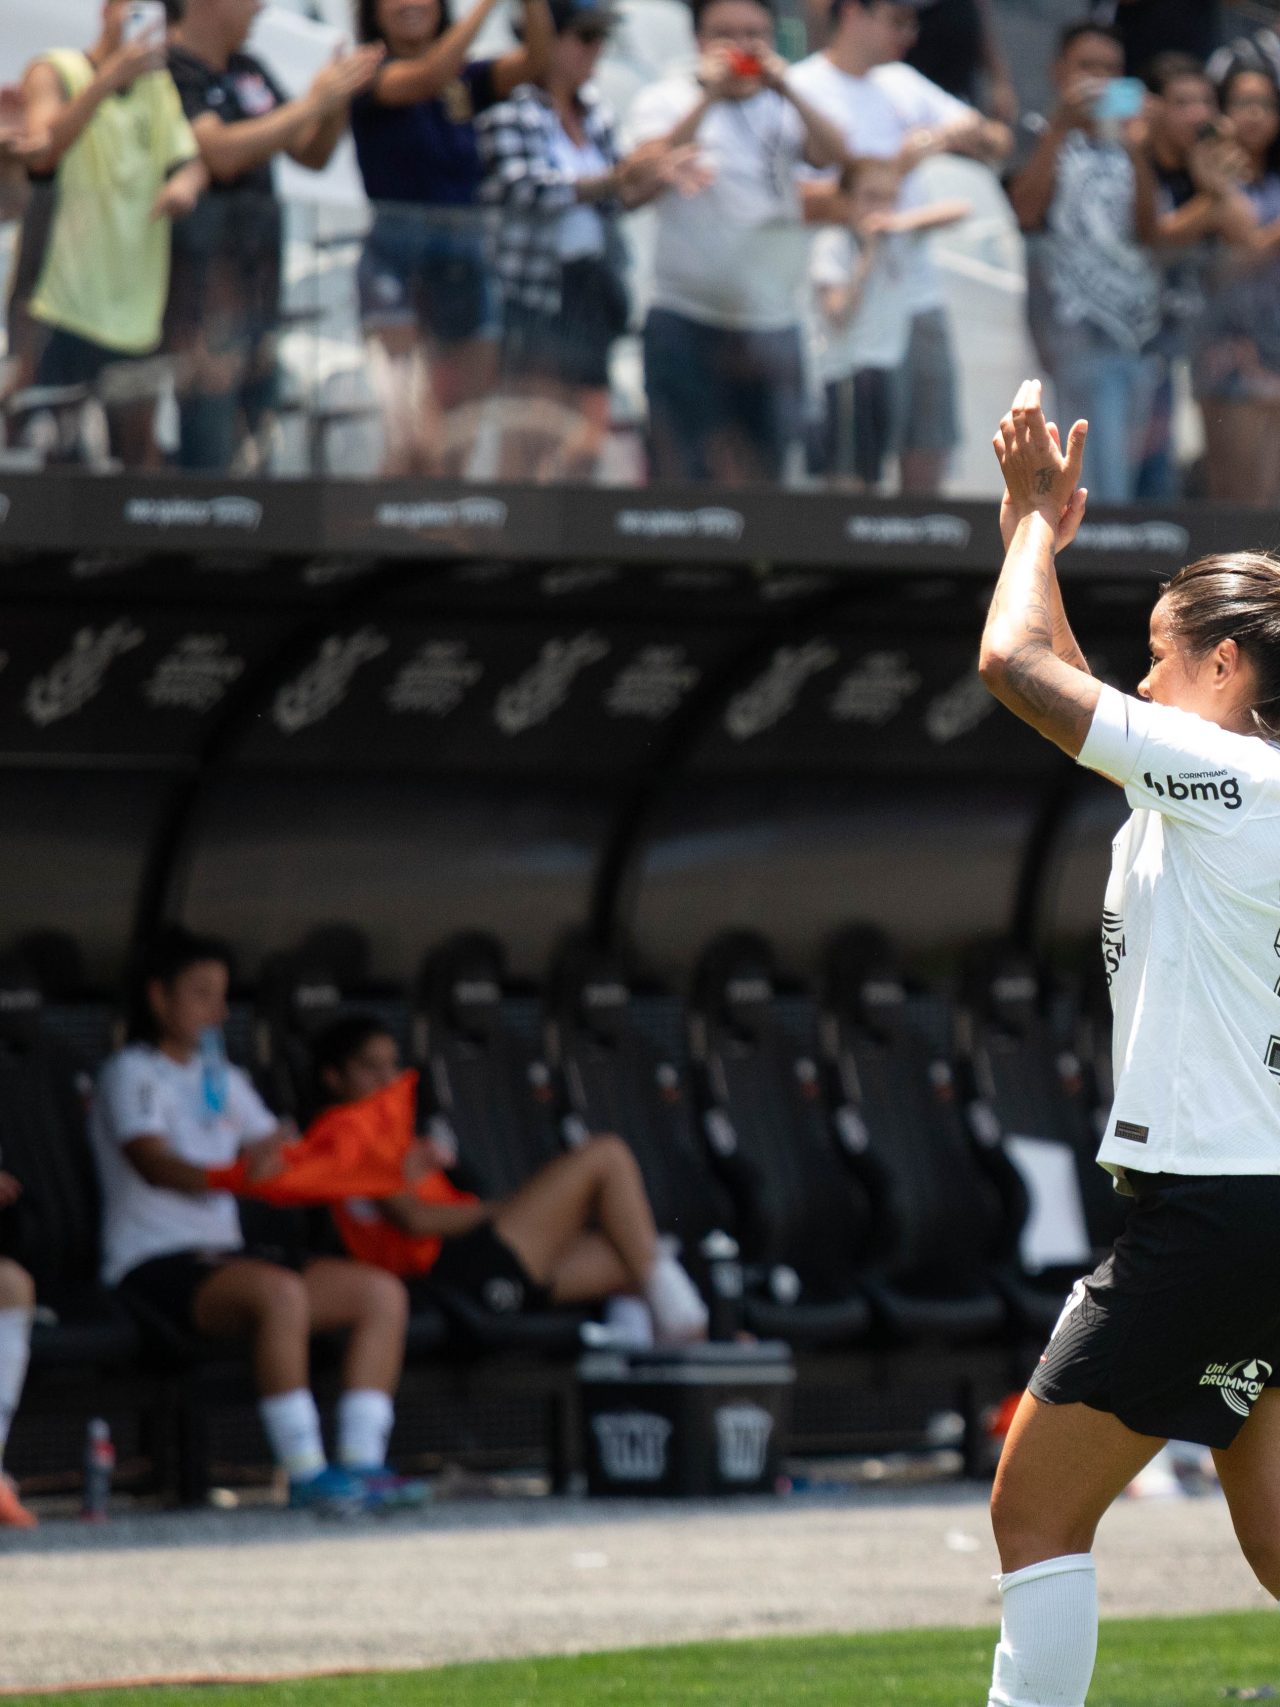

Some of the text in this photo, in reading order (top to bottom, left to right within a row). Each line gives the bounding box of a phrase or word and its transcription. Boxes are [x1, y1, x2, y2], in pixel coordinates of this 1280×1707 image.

[1178, 769, 1228, 780] CORINTHIANS
[1166, 775, 1243, 810] bmg
[1205, 1362, 1229, 1375] Uni
[1199, 1374, 1265, 1394] DRUMMON
